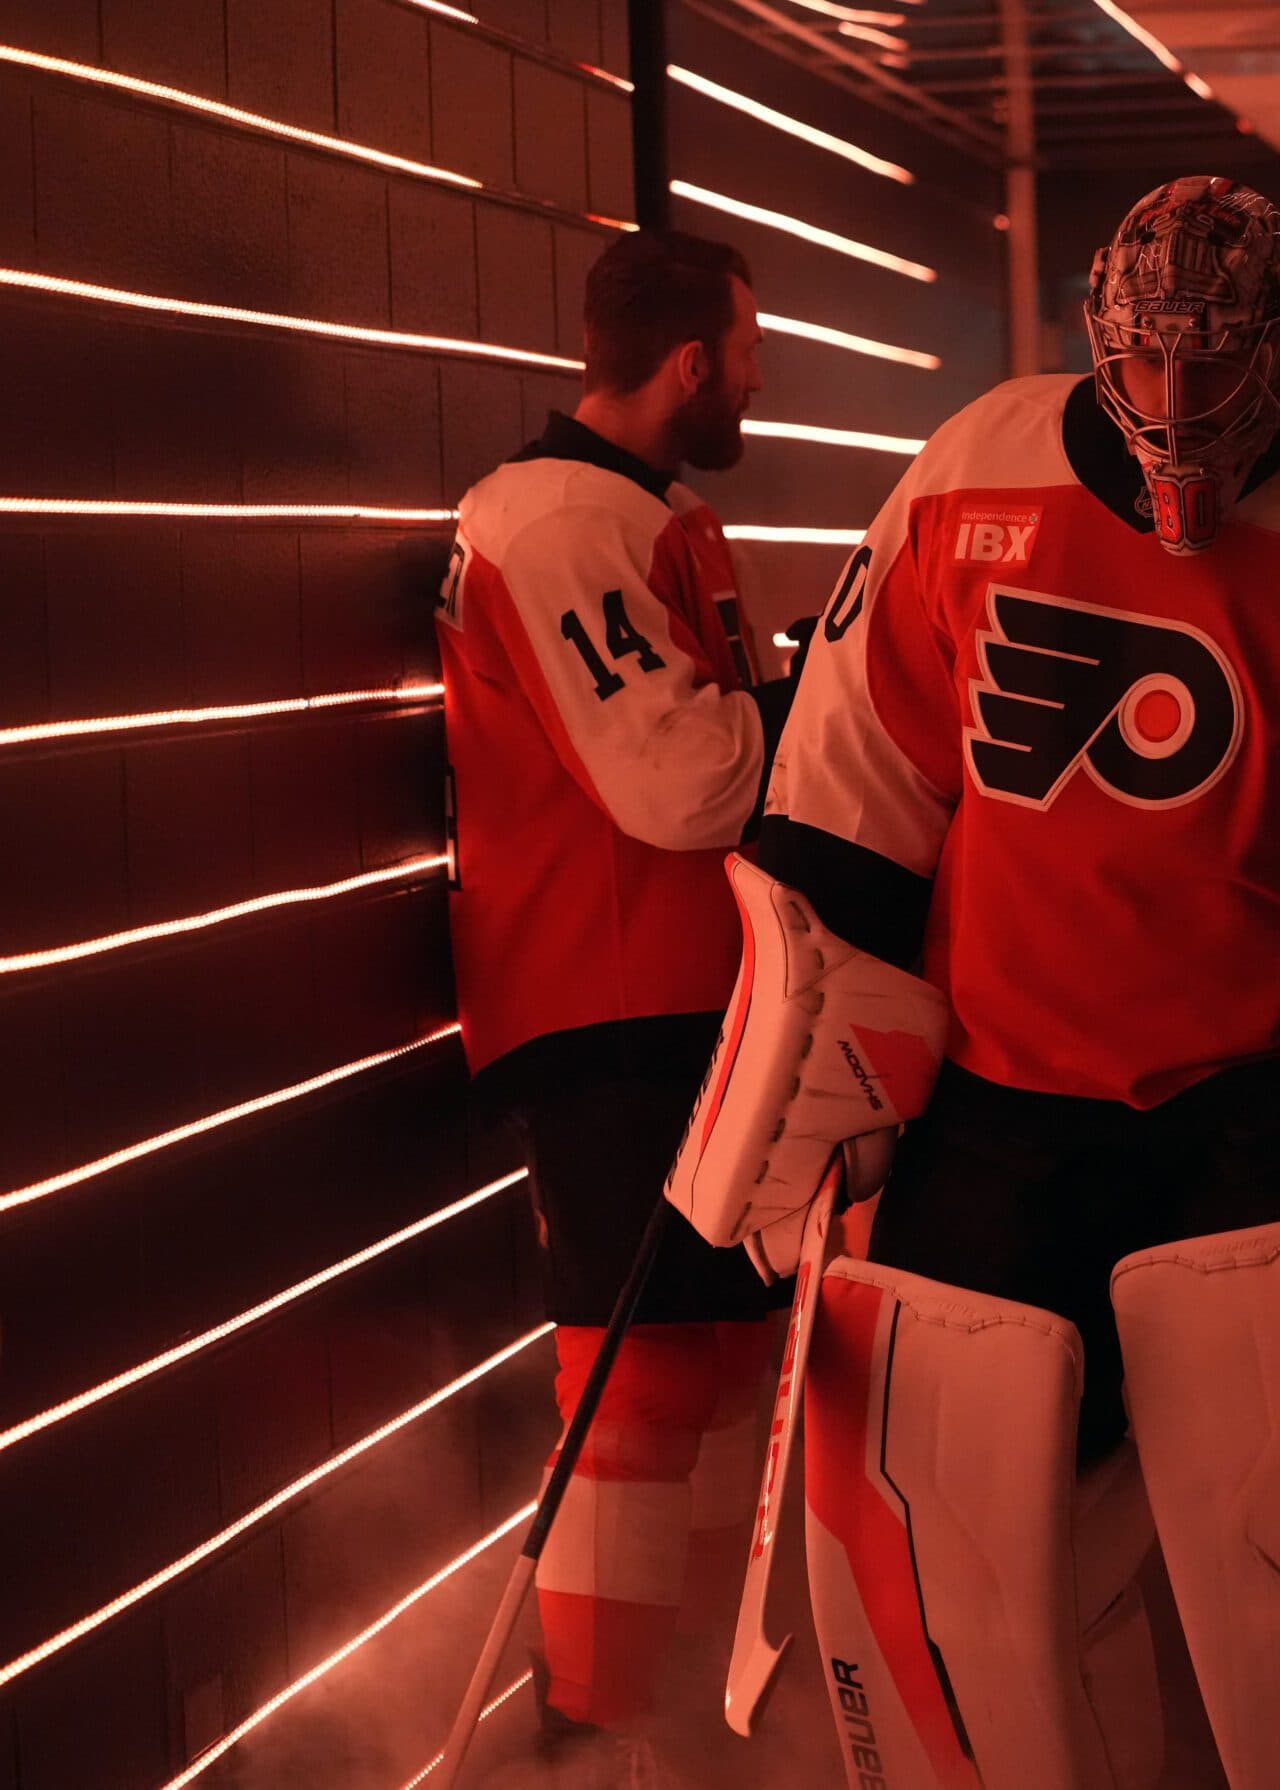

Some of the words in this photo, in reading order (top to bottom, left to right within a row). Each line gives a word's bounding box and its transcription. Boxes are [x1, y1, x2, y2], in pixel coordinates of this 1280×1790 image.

[954, 523, 1036, 563] IBX
[961, 511, 1028, 523] Independence
[1153, 478, 1218, 544] 80
[561, 590, 666, 701] 14
[836, 1040, 884, 1111] SHADOW
